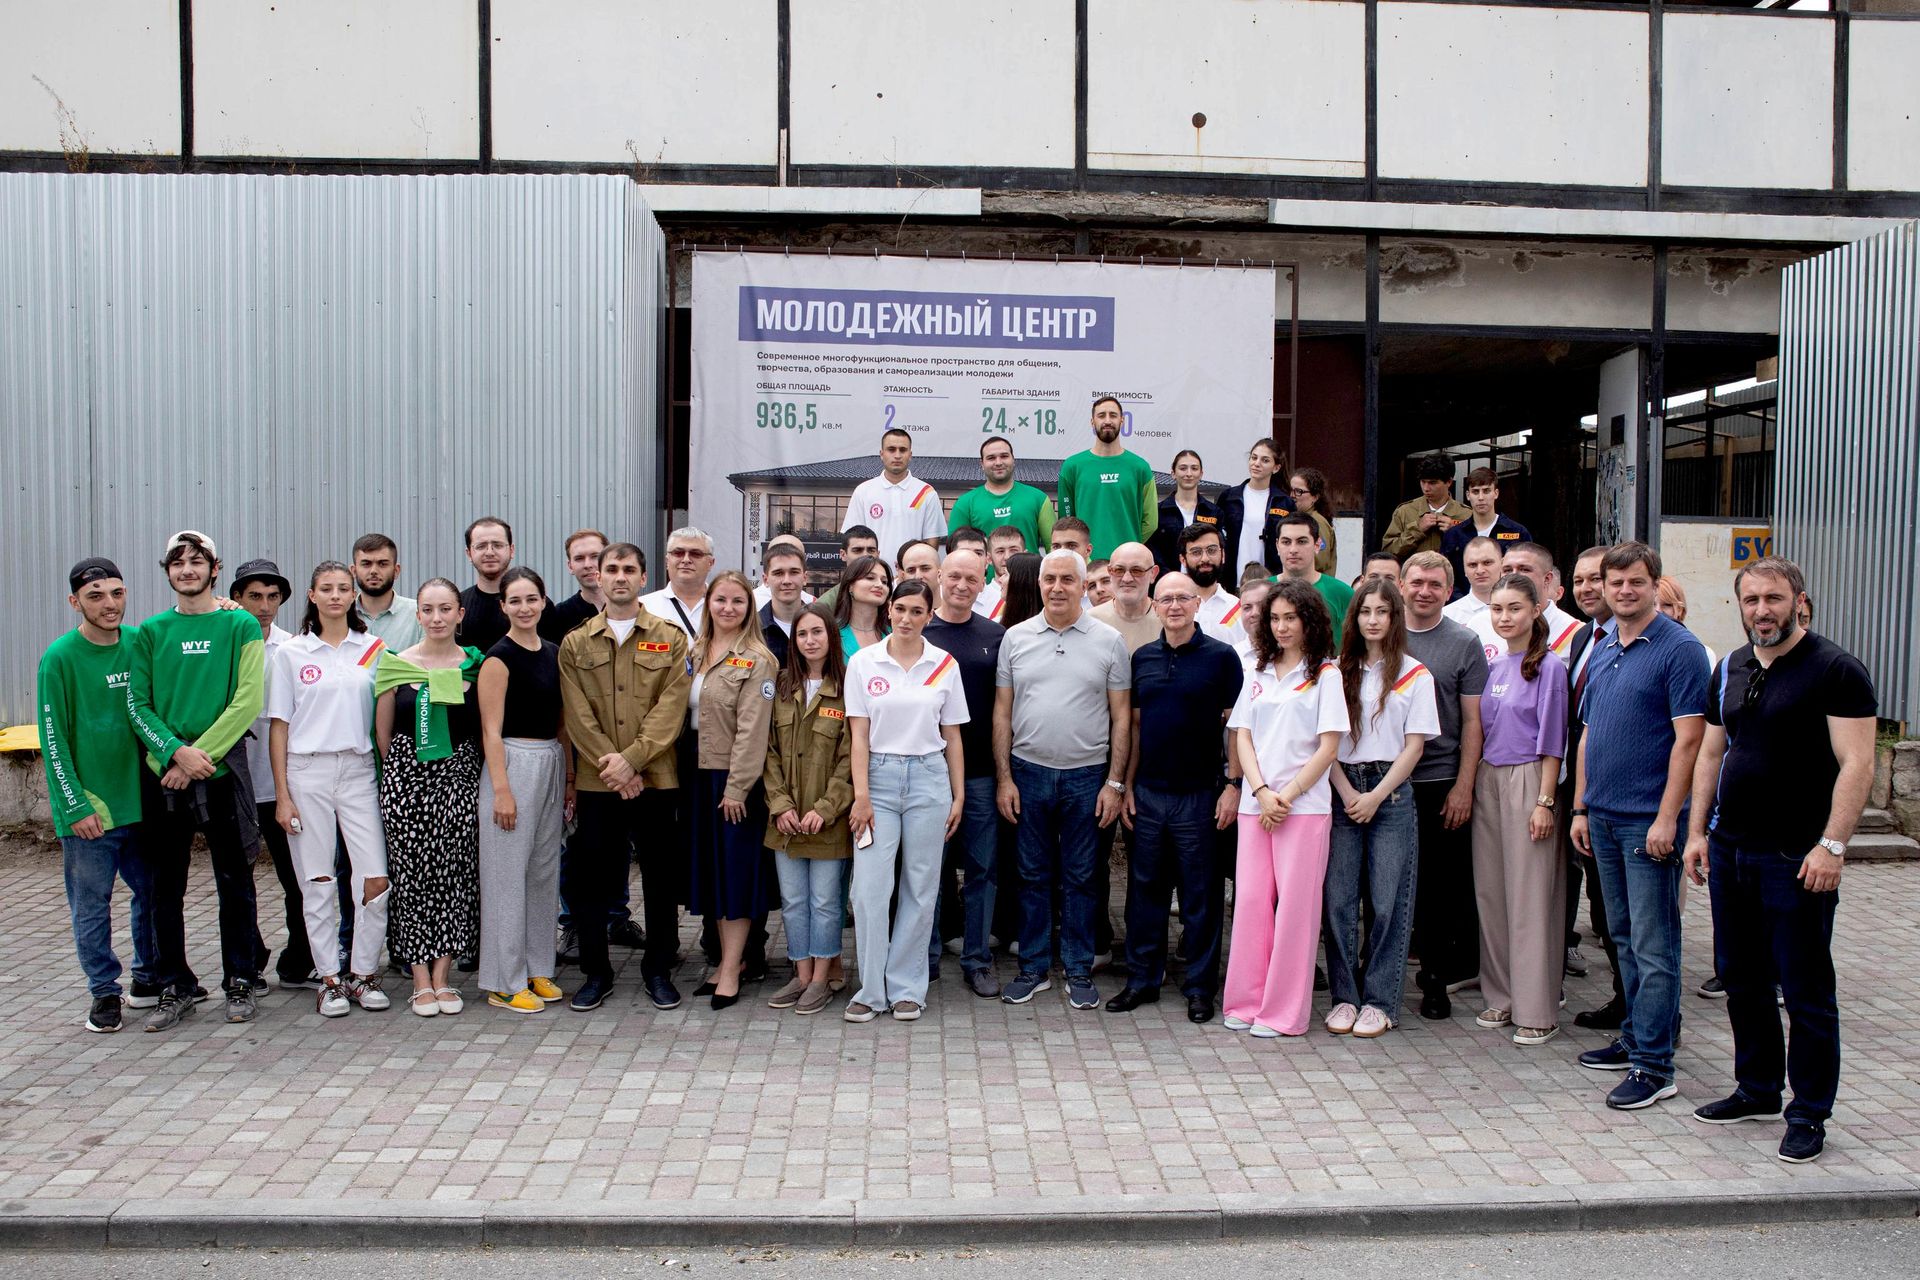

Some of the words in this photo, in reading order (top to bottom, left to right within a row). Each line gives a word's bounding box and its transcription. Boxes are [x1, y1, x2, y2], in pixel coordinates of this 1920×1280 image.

[757, 298, 992, 339] МОЛОДЕЖНЫЙ
[1002, 306, 1097, 341] ЦЕНТР
[757, 351, 820, 363] Современное
[823, 354, 928, 368] многофункциональное
[931, 357, 995, 368] пространство
[998, 359, 1014, 368] для
[1017, 358, 1061, 369] общения,
[757, 364, 812, 374] творчества,
[814, 365, 875, 376] образования
[885, 368, 963, 378] самореализации
[966, 370, 1014, 379] молодежи
[756, 382, 787, 391] ОБЩАЯ
[789, 383, 831, 392] ПЛОЩАДЬ
[883, 385, 933, 395] ЭТАЖНОСТЬ
[981, 388, 1025, 397] ГАБАРИТЫ
[1026, 389, 1060, 398] ЗДАНИЯ
[756, 401, 818, 434] 936,5
[884, 404, 896, 430] 2
[901, 424, 930, 432] этажа
[982, 406, 1008, 434] 24
[1034, 408, 1057, 435] 18
[1134, 430, 1172, 438] человек
[993, 506, 1012, 515] WYF
[181, 640, 211, 650] WYF
[106, 671, 130, 684] WYF
[420, 698, 429, 745] EVERYONE
[45, 717, 60, 759] MATTERS
[52, 760, 77, 806] EVERYONE
